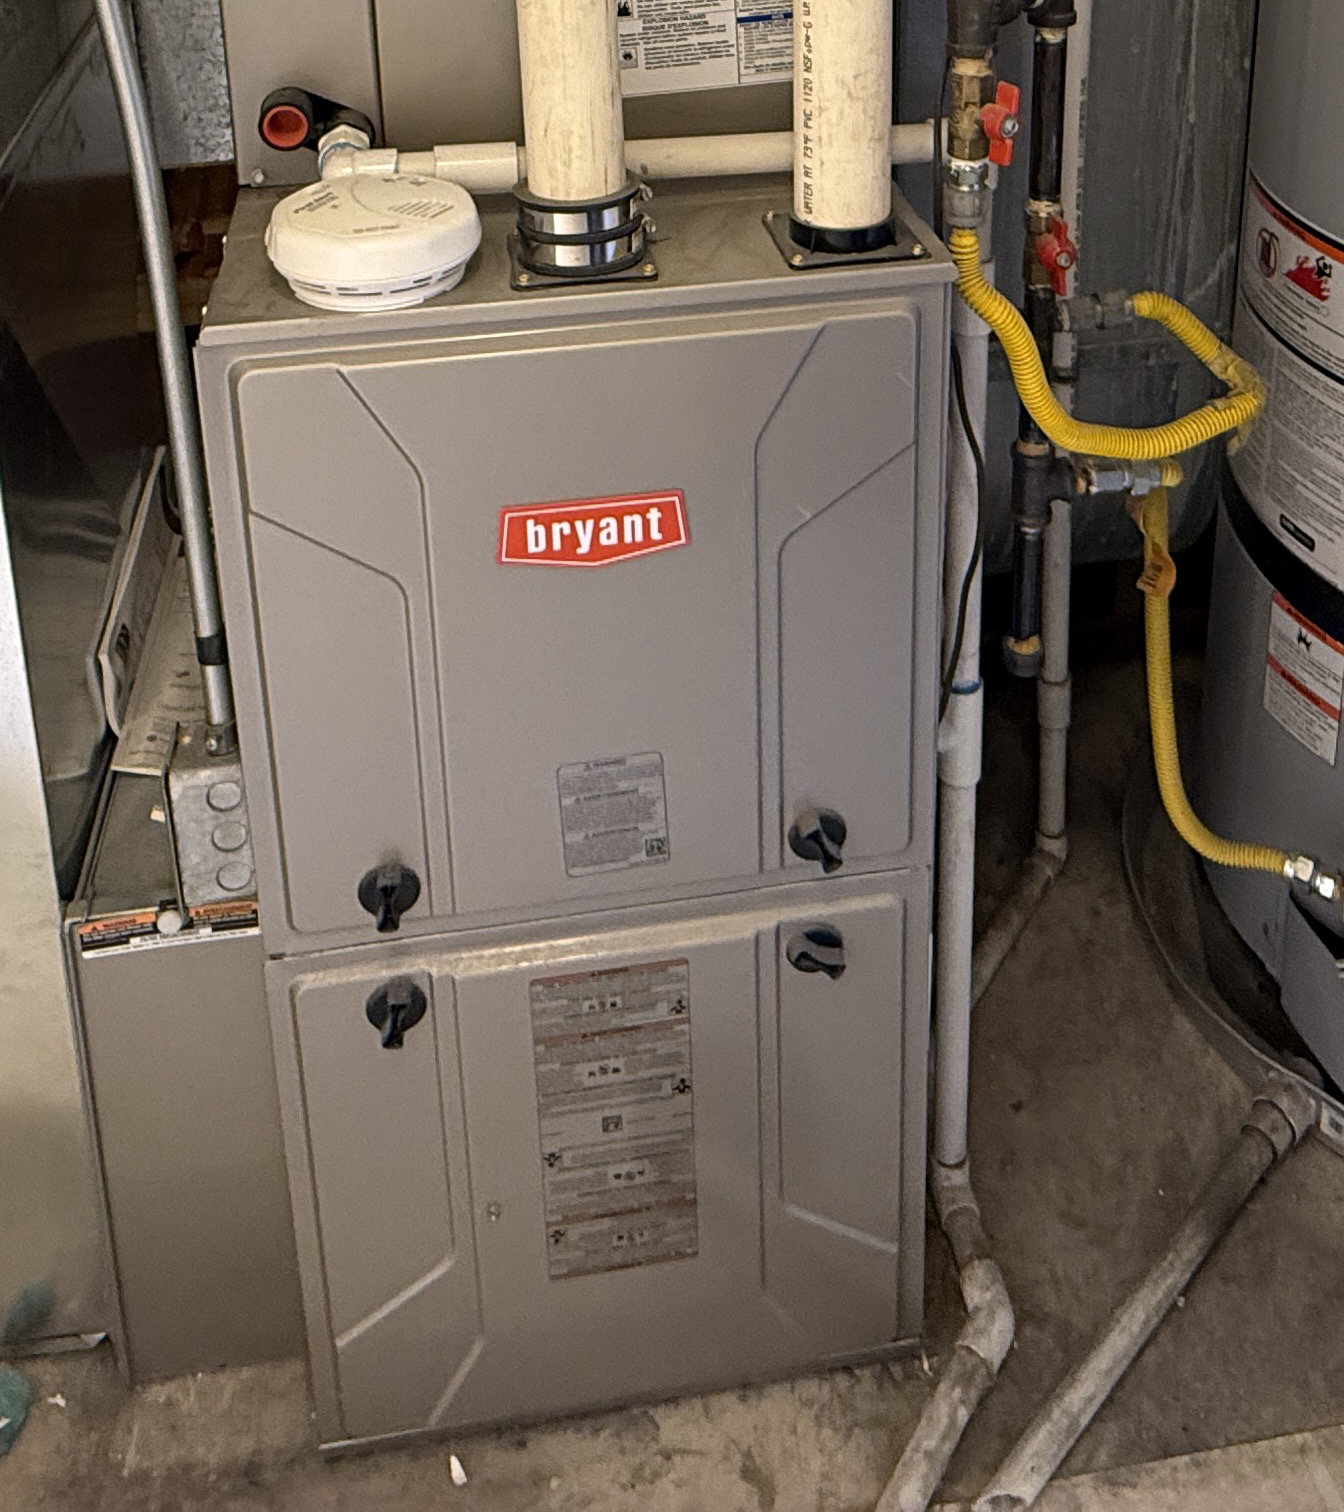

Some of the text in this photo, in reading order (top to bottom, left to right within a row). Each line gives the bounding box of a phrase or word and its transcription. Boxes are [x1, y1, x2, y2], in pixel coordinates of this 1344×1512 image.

[802, 77, 813, 103] 1120
[802, 109, 813, 130] PVC
[802, 164, 813, 179] AT
[802, 183, 813, 215] WATER
[526, 507, 663, 555] bryant
